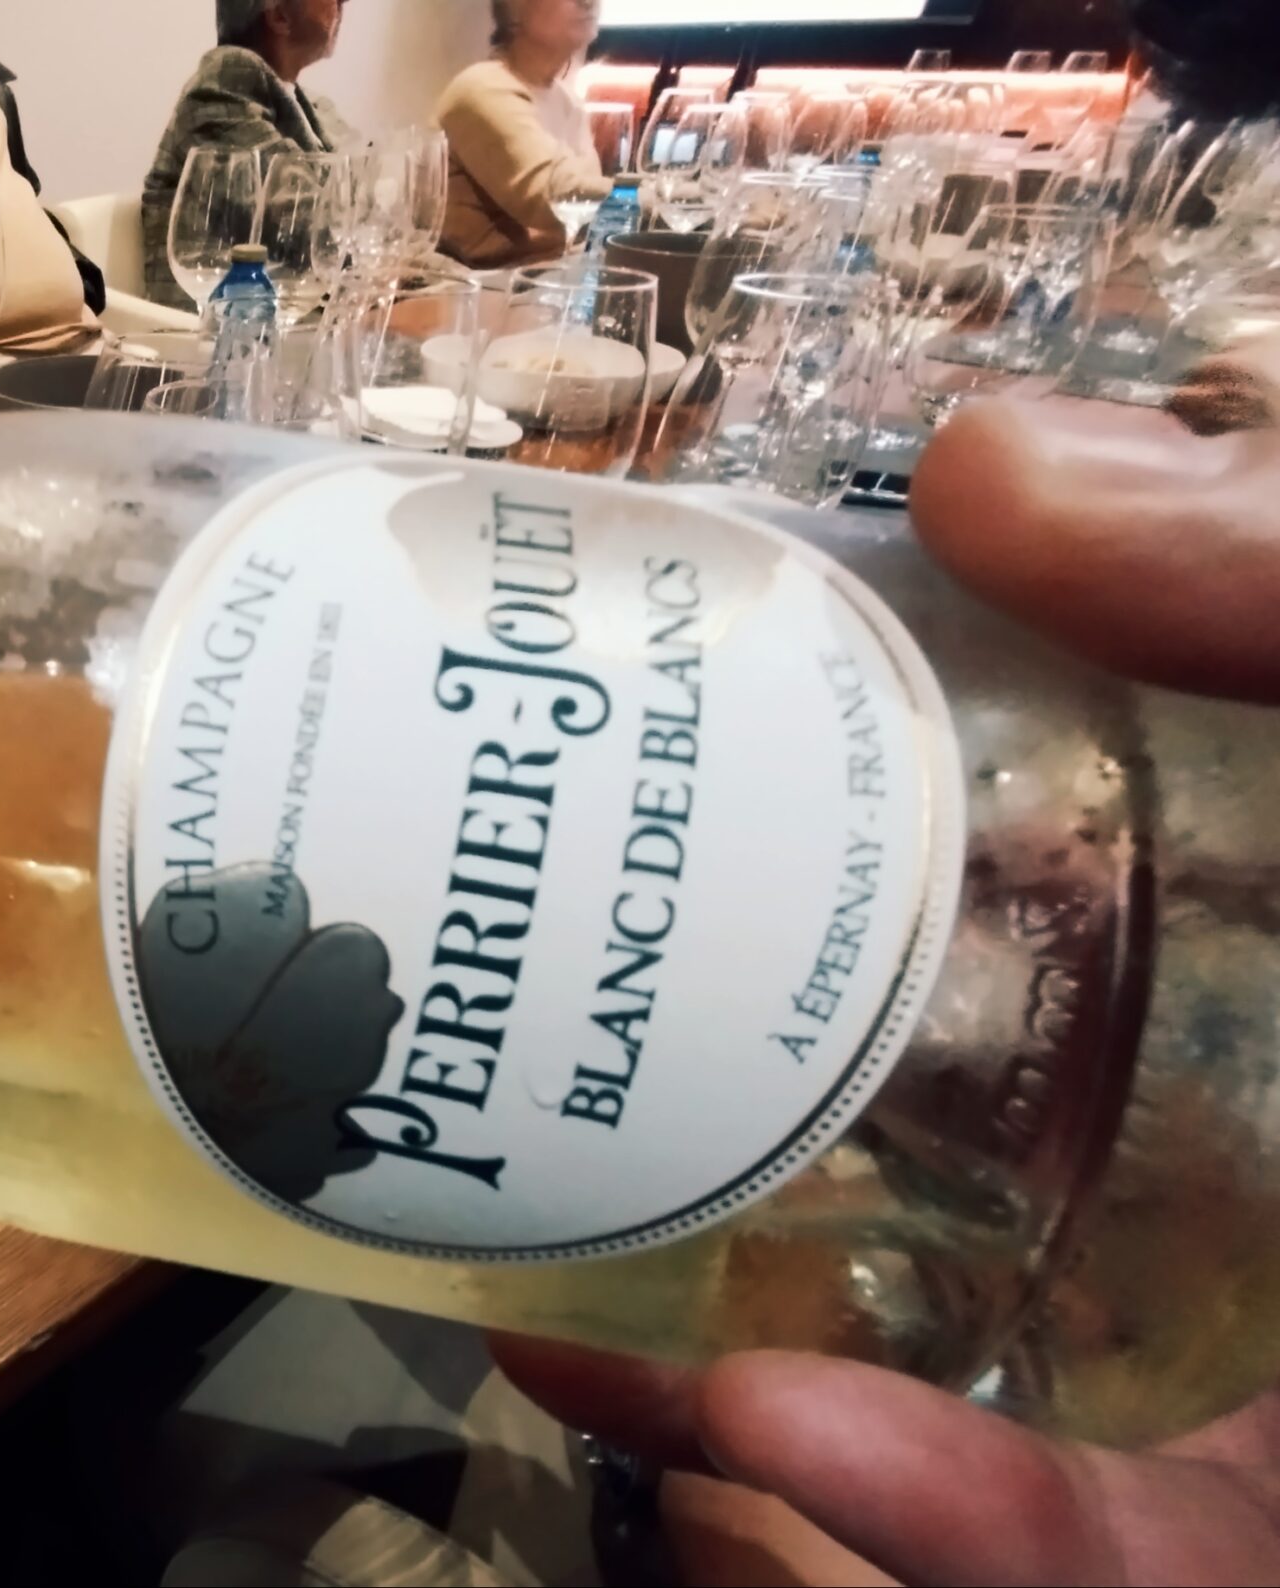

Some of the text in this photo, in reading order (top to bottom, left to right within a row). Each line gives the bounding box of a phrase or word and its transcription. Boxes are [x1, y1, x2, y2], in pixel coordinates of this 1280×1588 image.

[165, 551, 295, 956] CHAMPAGNE
[260, 802, 305, 920] MAISON
[285, 688, 328, 798] FONDÉE
[307, 647, 337, 684] EN
[818, 648, 886, 800] FRANCE
[562, 556, 703, 1130] BLANC DE BLANCS
[791, 828, 884, 1024] ÉPERNAY
[766, 1028, 818, 1064] À
